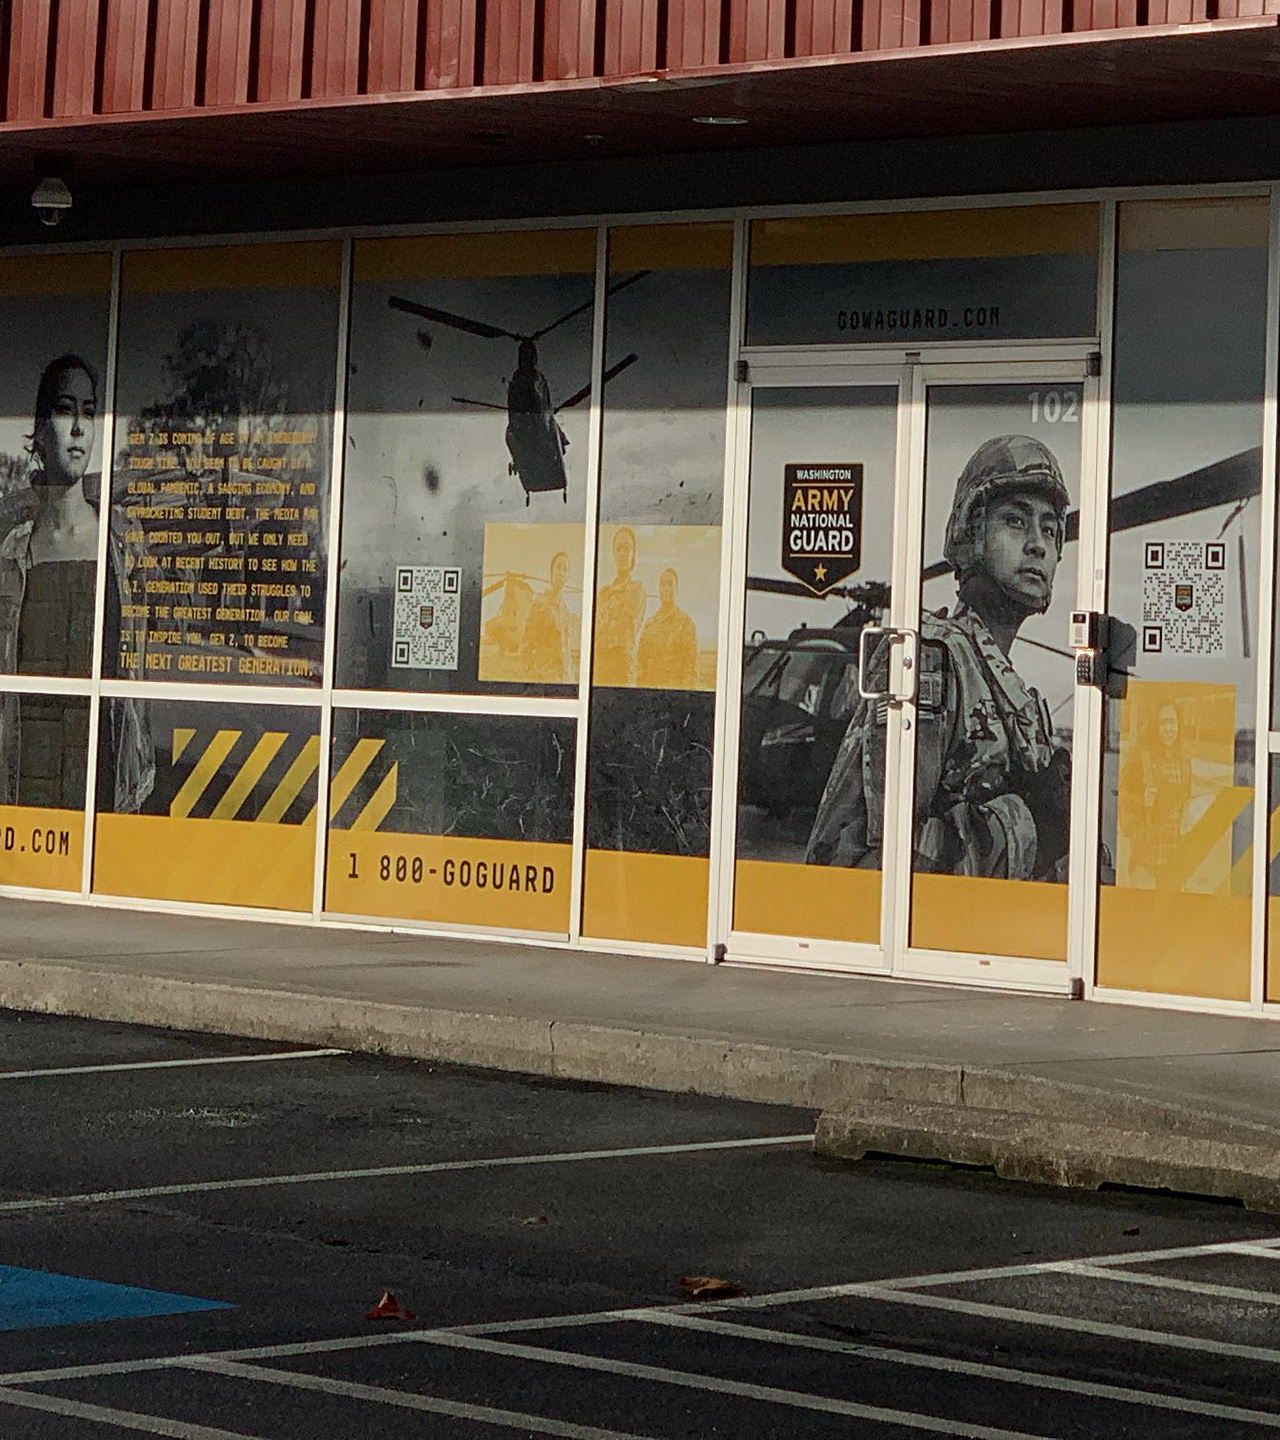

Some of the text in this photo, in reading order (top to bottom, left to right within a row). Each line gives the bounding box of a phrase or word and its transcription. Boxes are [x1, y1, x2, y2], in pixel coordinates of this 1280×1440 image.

[836, 306, 1000, 331] GOWAGUARD.COM
[1028, 391, 1079, 422] 102
[796, 469, 851, 480] WASHINGTON
[792, 489, 854, 511] ARMY
[188, 508, 222, 519] STUDENT
[790, 513, 854, 528] NATIONAL
[186, 532, 202, 545] YOU
[229, 532, 244, 545] BUT
[263, 533, 284, 545] ONLY
[288, 533, 308, 545] NEED
[789, 530, 854, 551] GUARD
[176, 557, 204, 570] RECENT
[208, 558, 244, 570] HISTORY
[248, 558, 258, 571] TO
[262, 559, 276, 571] SEE
[281, 559, 296, 571] HOW
[302, 559, 316, 572] THE
[146, 582, 194, 594] GENERATION
[198, 582, 218, 595] USED
[222, 583, 247, 596] THEIR
[251, 584, 296, 596] STRUGGLES
[300, 585, 311, 597] TO
[155, 606, 169, 619] THE
[173, 607, 212, 620] GREATEST
[274, 610, 289, 623] OUR
[149, 631, 182, 644] INSPIRE
[209, 633, 224, 645] GEN
[244, 634, 254, 647] TO
[258, 635, 288, 647] BECOME
[120, 652, 314, 675] THE NEXT GREATEST GENERATION.
[348, 853, 555, 893] 1 800-GOGUARD
